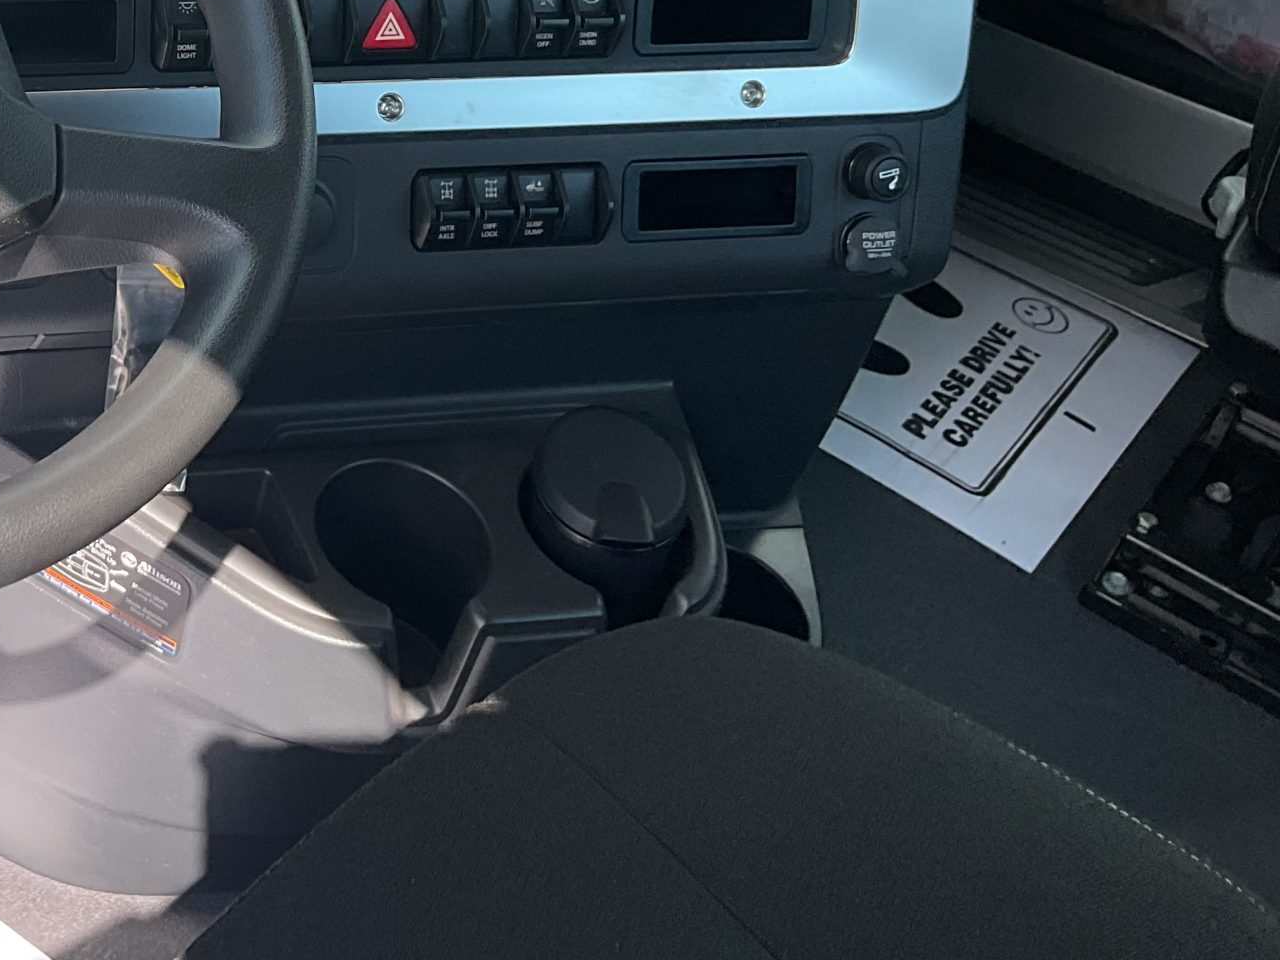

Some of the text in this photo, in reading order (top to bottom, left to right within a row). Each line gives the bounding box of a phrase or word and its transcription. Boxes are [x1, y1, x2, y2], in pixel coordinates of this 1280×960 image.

[862, 230, 896, 240] POWER
[862, 239, 896, 249] OUTLET
[901, 321, 1017, 440] PLEASE DRIVE
[942, 344, 1043, 448] CAREFULLY!
[139, 561, 182, 591] Allison
